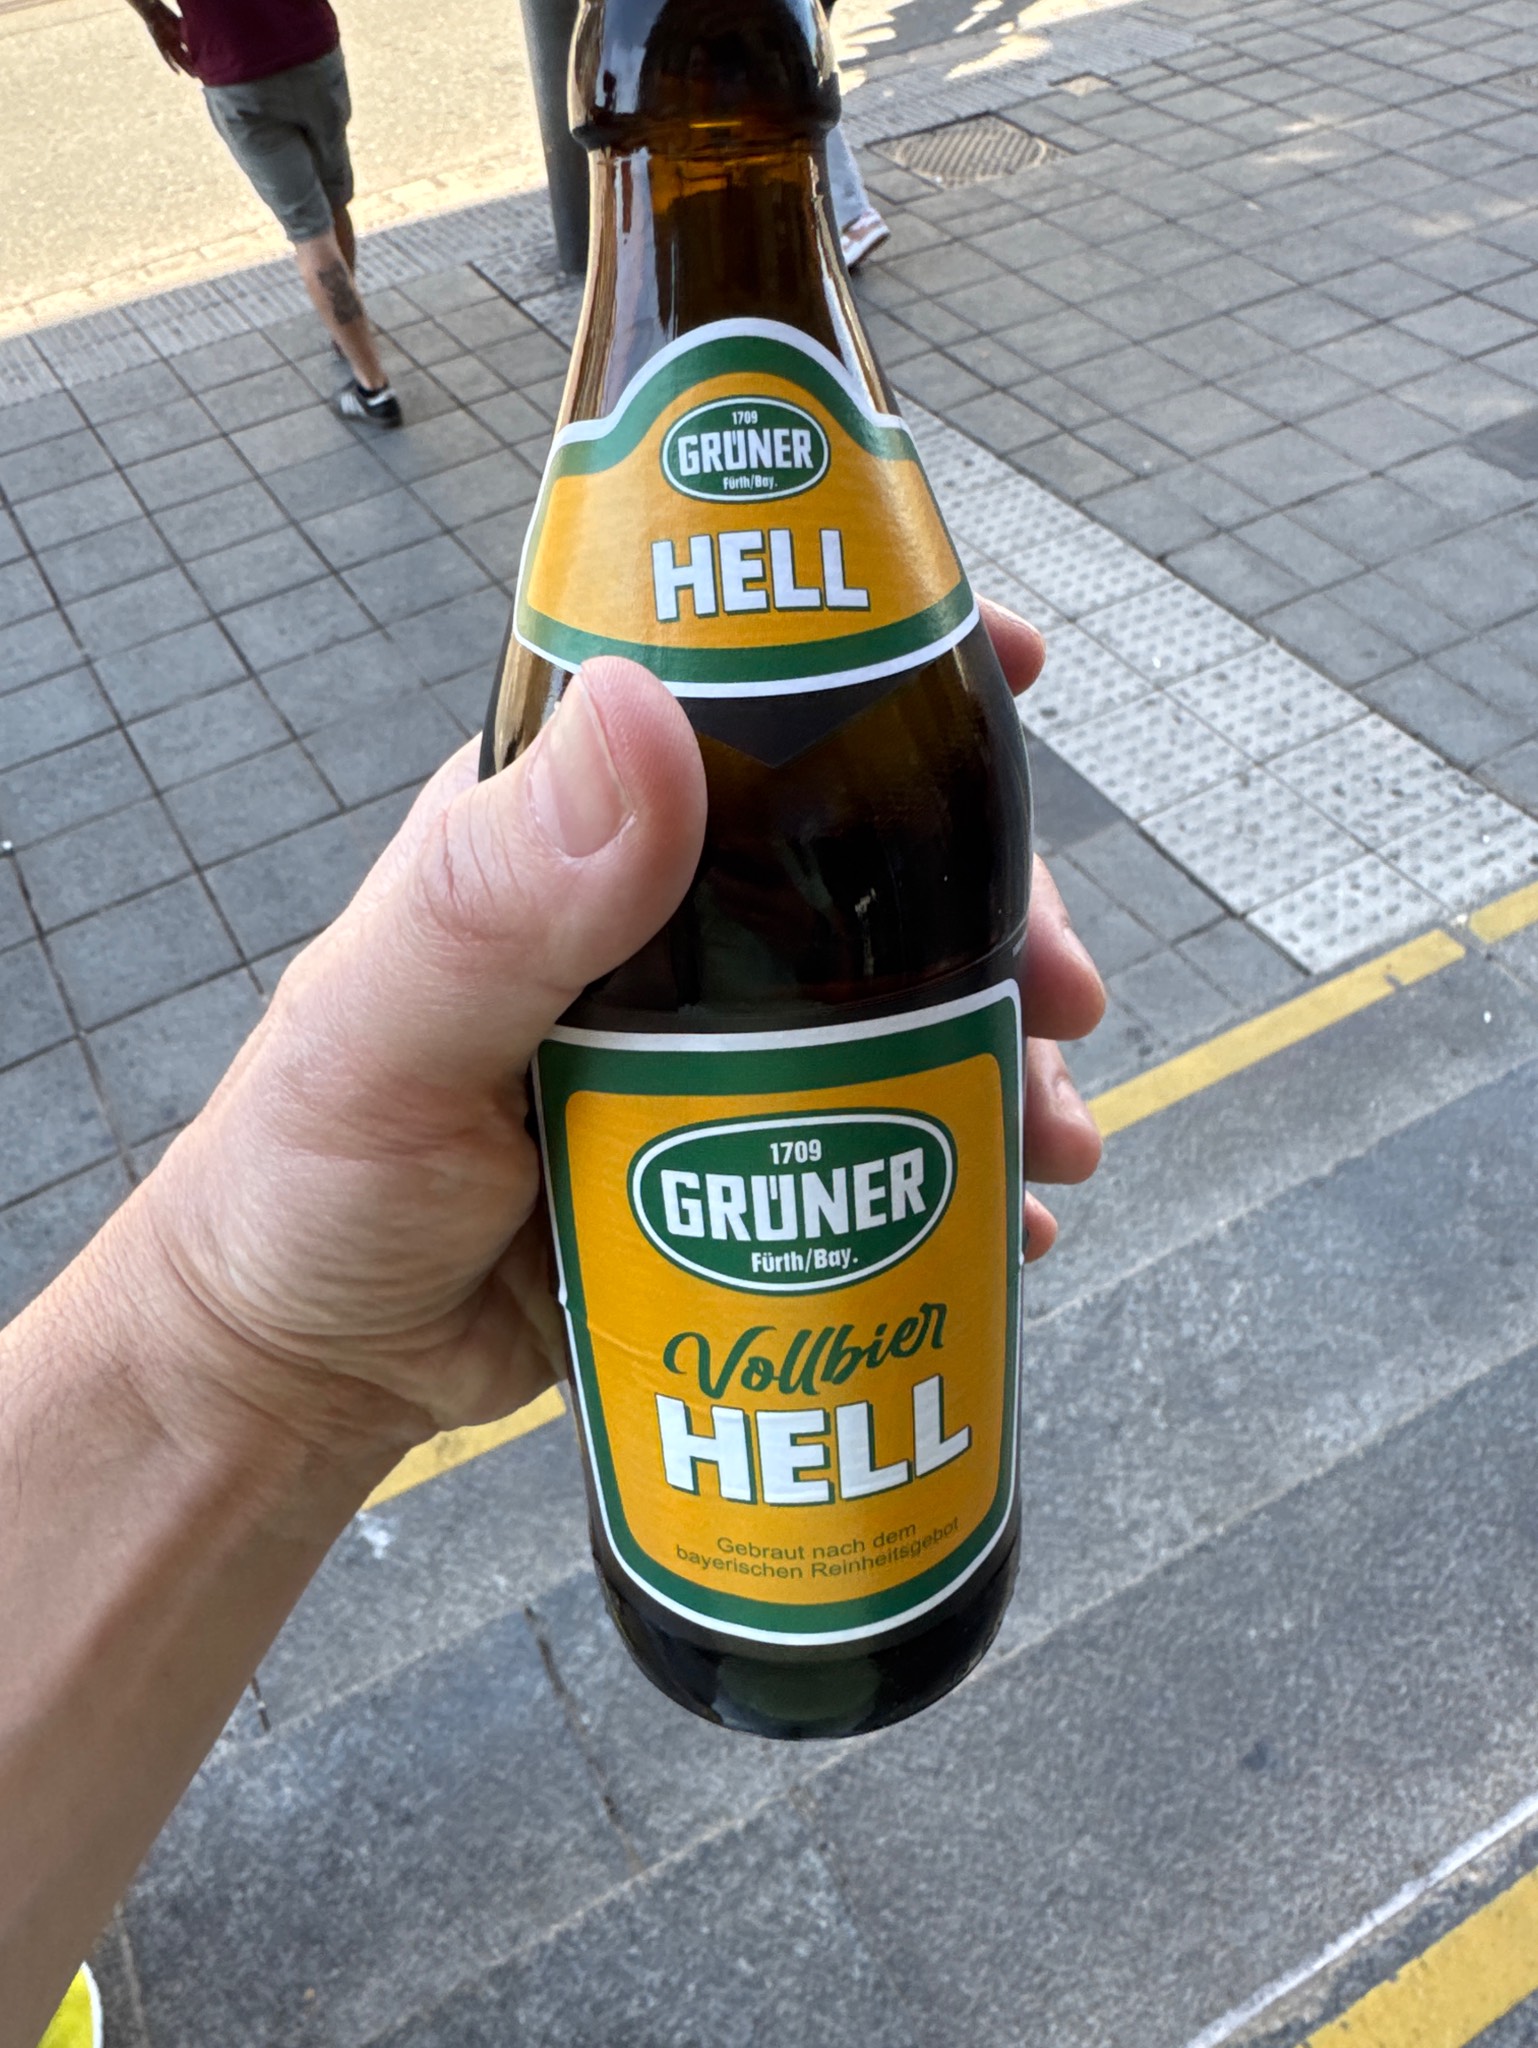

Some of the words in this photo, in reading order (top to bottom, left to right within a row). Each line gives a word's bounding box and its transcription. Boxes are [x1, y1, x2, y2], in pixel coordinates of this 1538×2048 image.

[732, 411, 758, 425] 1709
[678, 428, 814, 477] GRÜNER
[723, 475, 778, 490] Fürth/Bay.
[652, 528, 870, 623] HELL
[770, 1139, 822, 1165] 1709
[660, 1147, 926, 1242] GRÜNER
[751, 1248, 859, 1273] Fürth/Bay.
[663, 1302, 947, 1400] Vollbier
[655, 1373, 972, 1506] HELL
[676, 1544, 803, 1579] bayerischen
[811, 1516, 959, 1578] Reinheitsgebot
[717, 1537, 805, 1561] Gebraut
[812, 1539, 866, 1560] nach
[872, 1523, 916, 1548] dem
